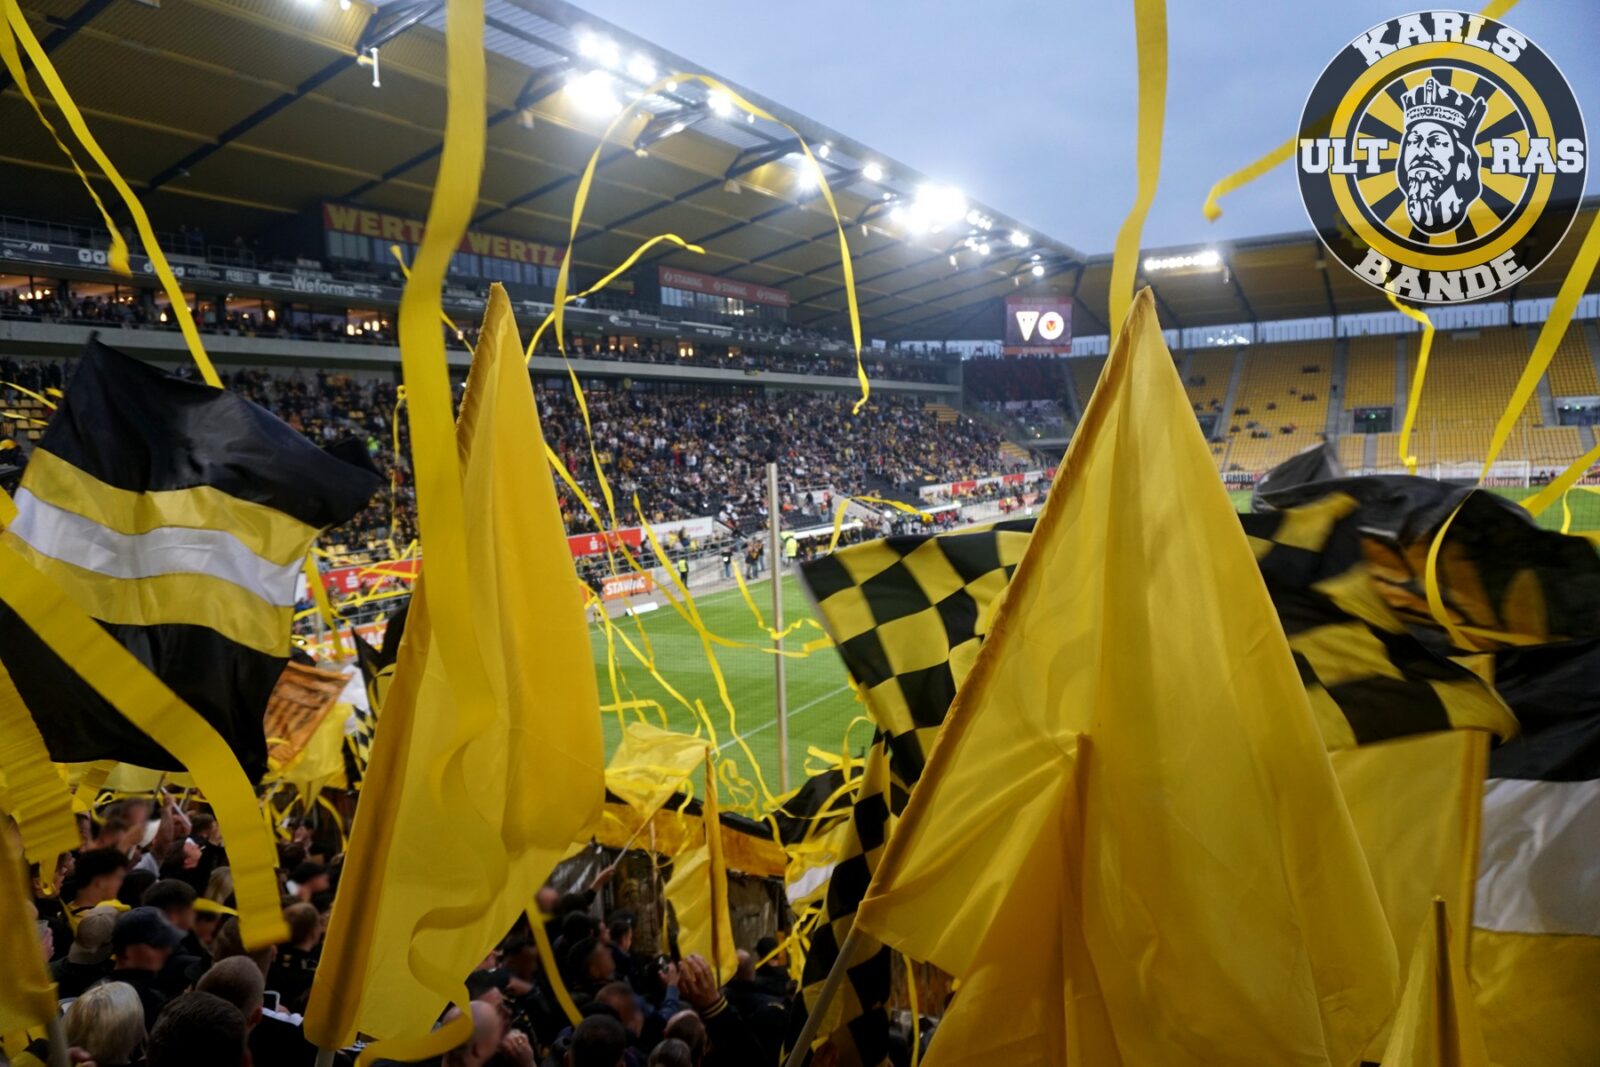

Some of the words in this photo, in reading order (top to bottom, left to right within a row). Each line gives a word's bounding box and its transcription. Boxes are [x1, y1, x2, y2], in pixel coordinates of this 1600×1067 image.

[326, 204, 426, 243] WERT
[467, 231, 562, 267] WERTZ
[292, 276, 355, 296] Weforma
